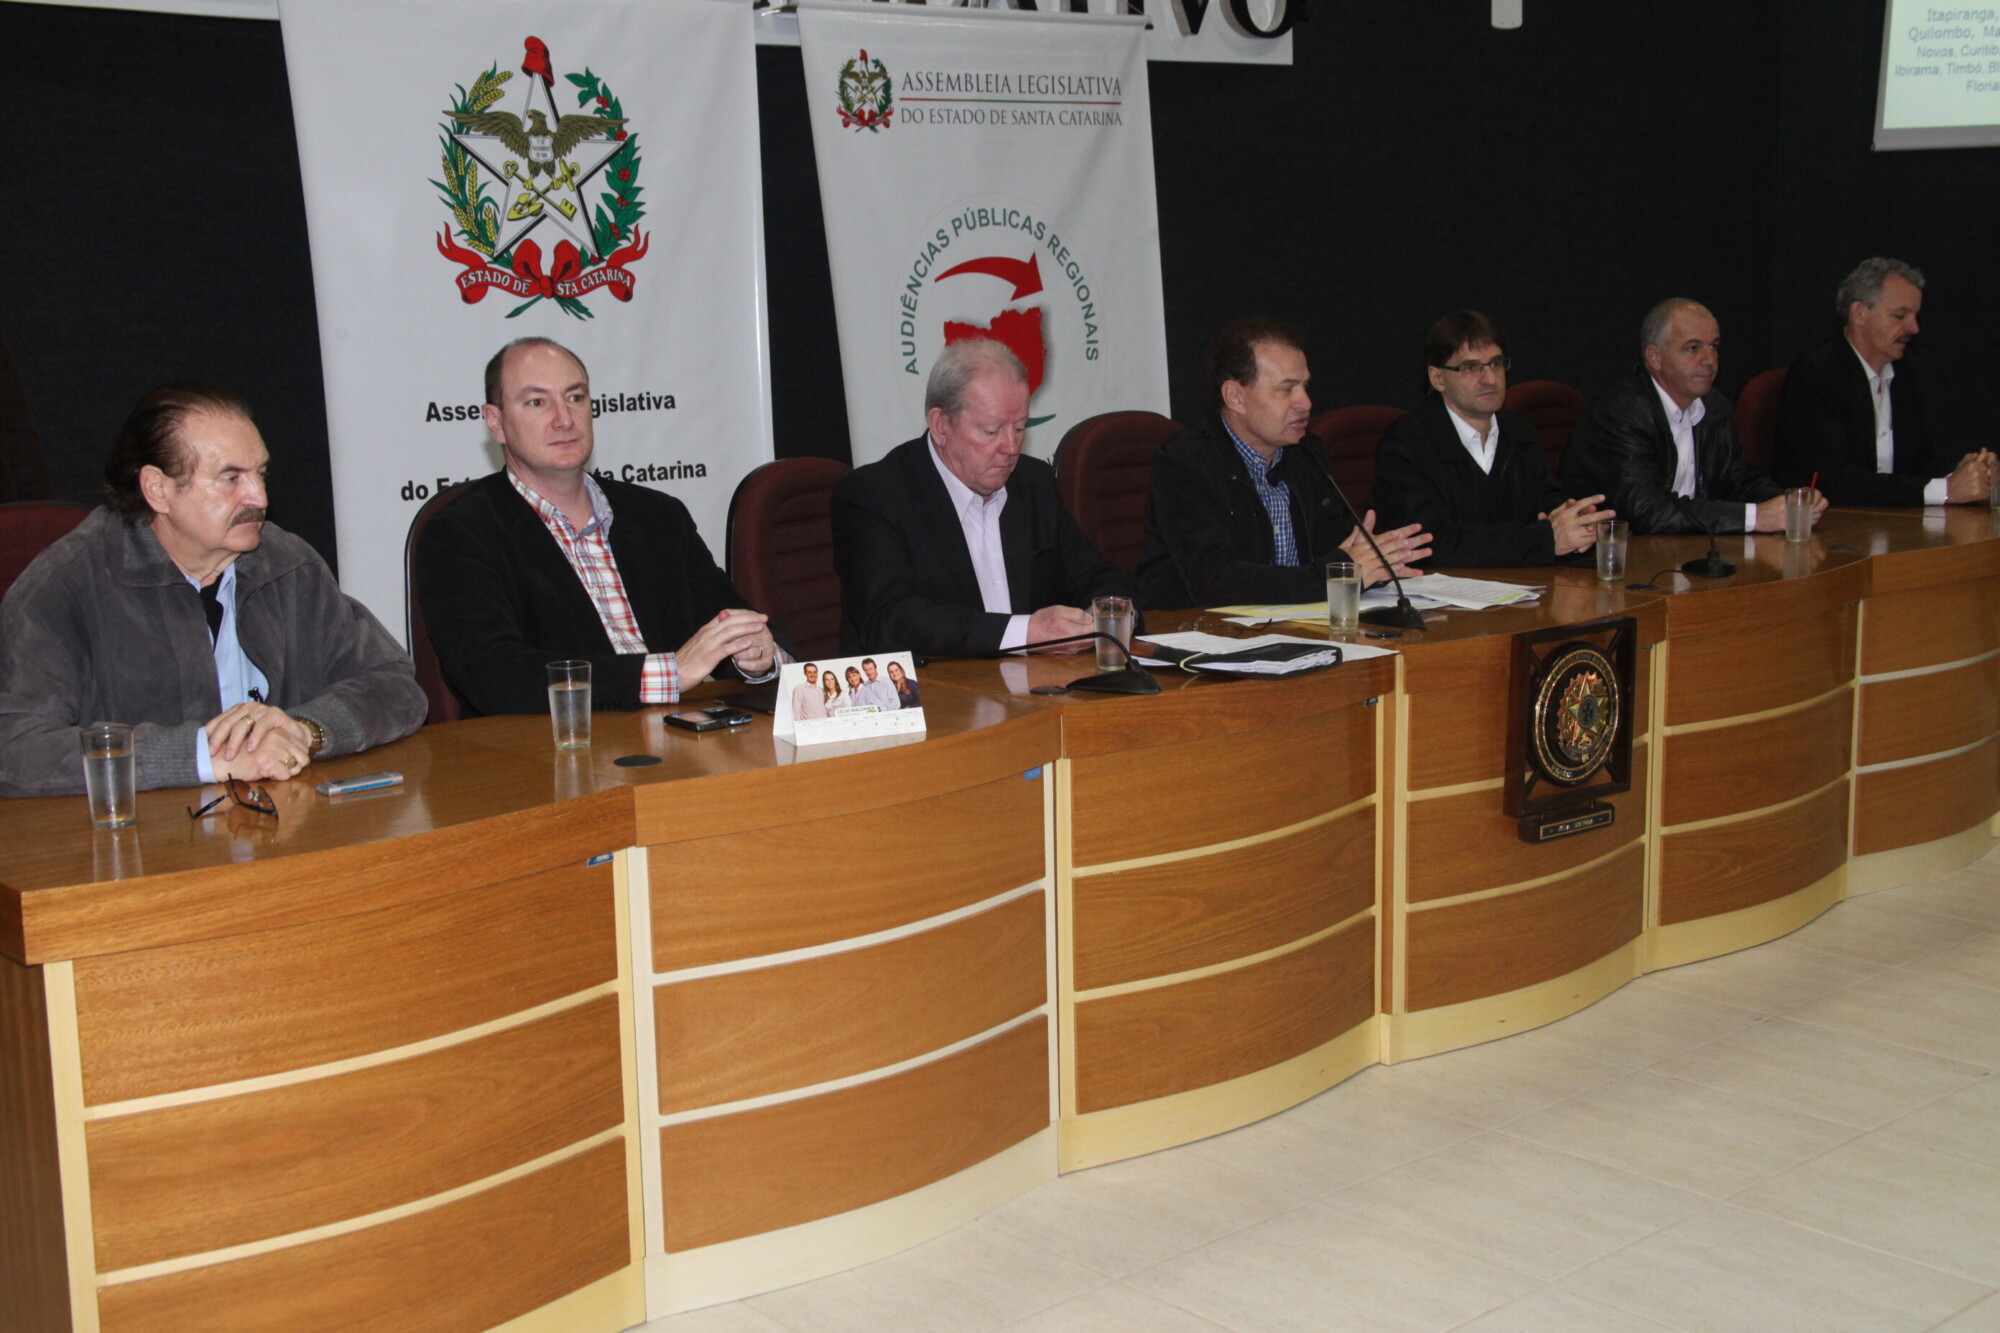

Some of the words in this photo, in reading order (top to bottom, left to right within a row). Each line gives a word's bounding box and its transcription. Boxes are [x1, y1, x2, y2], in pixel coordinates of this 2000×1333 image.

[1960, 44, 2000, 57] Curitib
[902, 72, 1012, 93] ASSEMBLEIA
[1018, 75, 1122, 96] LEGISLATIVA
[1966, 80, 2000, 92] Floria
[901, 107, 924, 124] DO
[929, 108, 985, 125] ESTADO
[990, 109, 1007, 125] DE
[1011, 110, 1055, 126] SANTA
[1059, 111, 1122, 126] CATARINA
[461, 270, 510, 289] ESTADO
[513, 279, 529, 295] DE
[581, 268, 631, 289] CATARINA
[900, 228, 950, 376] AUDIÊNCIAS
[951, 206, 1046, 241] PÚBLICAS
[1047, 233, 1099, 362] REGIONAIS
[591, 391, 676, 418] gislativa
[400, 480, 429, 501] do
[621, 461, 707, 484] Catarina
